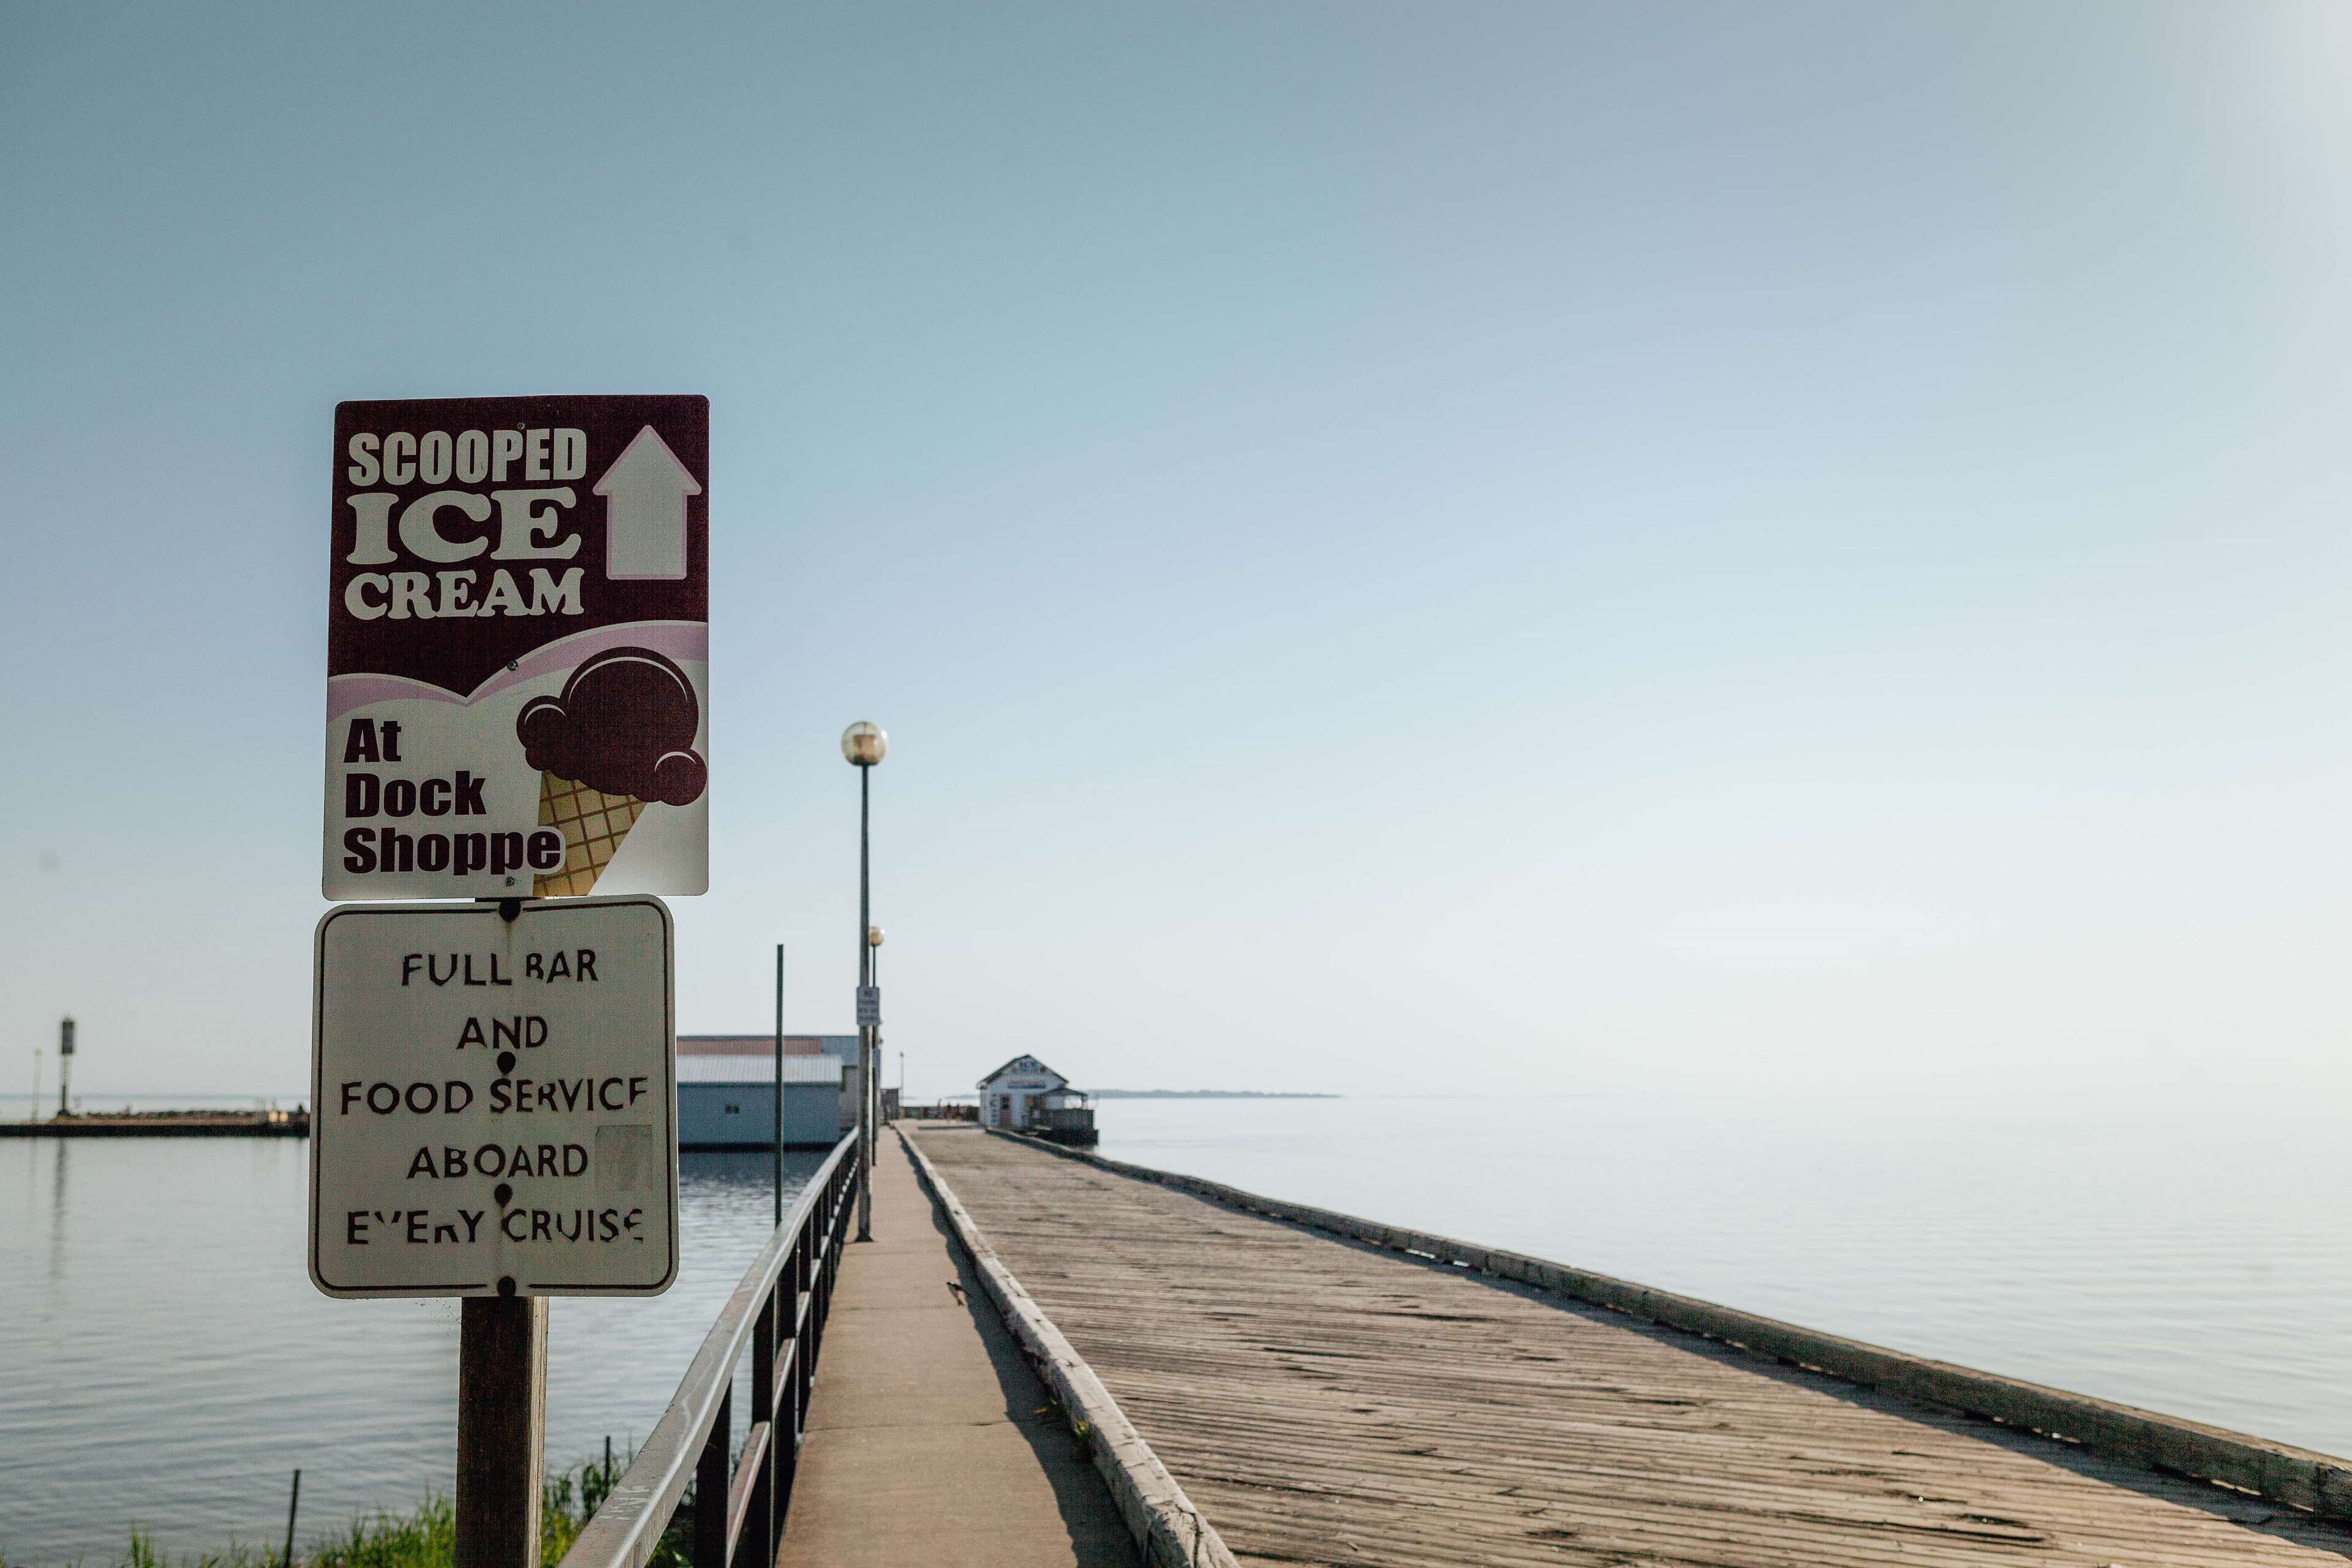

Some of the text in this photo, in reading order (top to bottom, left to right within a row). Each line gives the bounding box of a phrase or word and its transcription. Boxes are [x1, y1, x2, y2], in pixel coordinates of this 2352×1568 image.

[349, 428, 587, 486] SCOOPED
[347, 488, 581, 564] ICE
[345, 567, 584, 620] CREAM
[344, 718, 401, 763] At
[345, 771, 486, 818] Dock
[344, 827, 560, 875] Shoppe
[402, 949, 598, 986] FULL BAR
[457, 1016, 548, 1049] AND
[341, 1081, 473, 1115] FOOD
[407, 1144, 587, 1179] ABOARD
